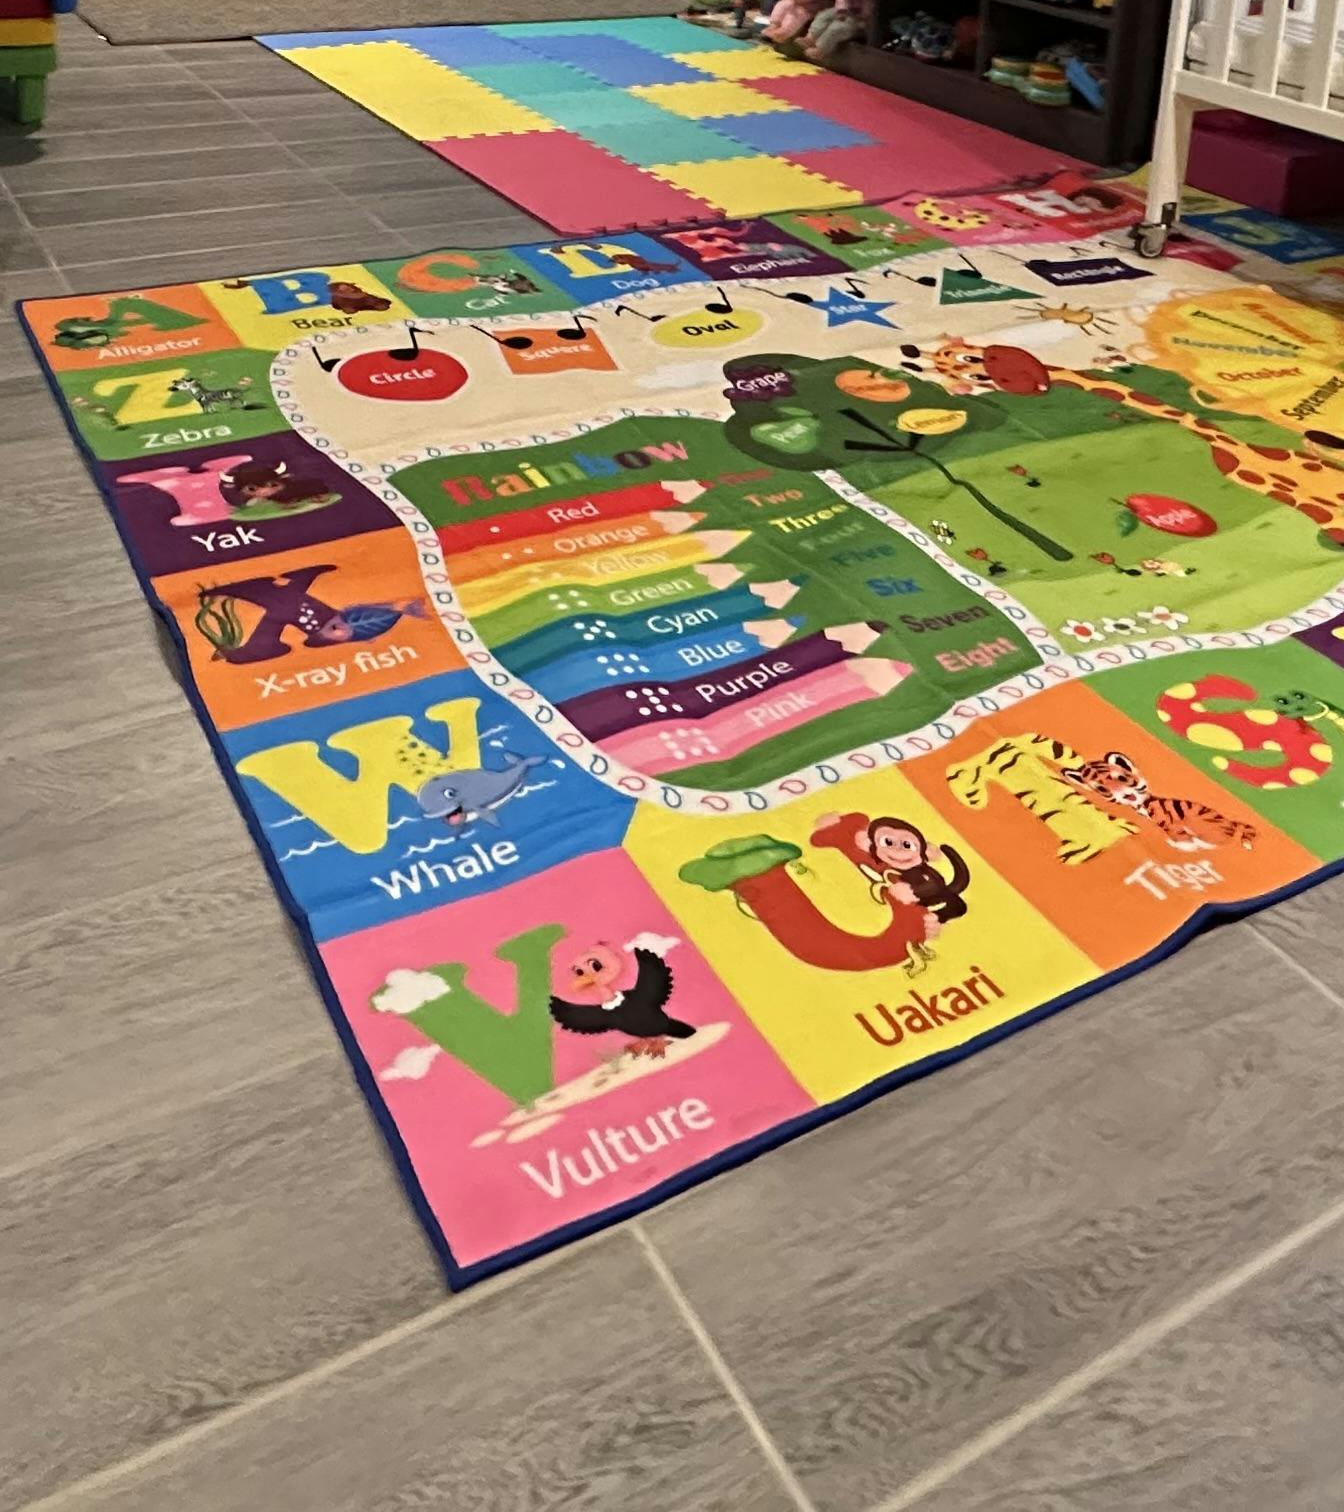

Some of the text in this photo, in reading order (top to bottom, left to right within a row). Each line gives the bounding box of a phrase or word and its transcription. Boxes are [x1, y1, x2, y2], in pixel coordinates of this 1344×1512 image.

[397, 253, 480, 293] C
[729, 256, 812, 275] Elephant
[247, 271, 334, 315] B
[611, 275, 662, 291] Dog
[464, 294, 512, 312] Cat
[828, 303, 869, 317] Star
[290, 314, 354, 332] Bear
[681, 319, 741, 338] Oval
[97, 336, 202, 361] Alligator
[369, 366, 437, 386] Circle
[736, 370, 789, 392] Grape
[93, 367, 206, 426] Z
[140, 423, 233, 450] Zebra
[440, 440, 690, 507] Rainbow
[546, 500, 600, 524] Red
[742, 487, 805, 508] Two
[768, 503, 849, 534] Three
[191, 525, 265, 554] Yak
[553, 522, 650, 554] Orange
[582, 550, 670, 577] Yellow
[609, 576, 695, 607] Green
[646, 605, 721, 635] Cyan
[899, 605, 992, 634] Seven
[676, 639, 747, 667] Blue
[935, 637, 1021, 674] Eight
[254, 643, 418, 699] X-ray fish
[694, 660, 795, 703] Purple
[743, 691, 819, 728] Pink
[1156, 673, 1334, 792] S
[235, 696, 484, 856] W
[367, 833, 523, 905] Whale
[1122, 855, 1227, 902] Tiger
[854, 963, 1007, 1051] Uakari
[518, 1090, 717, 1202] Vulture
